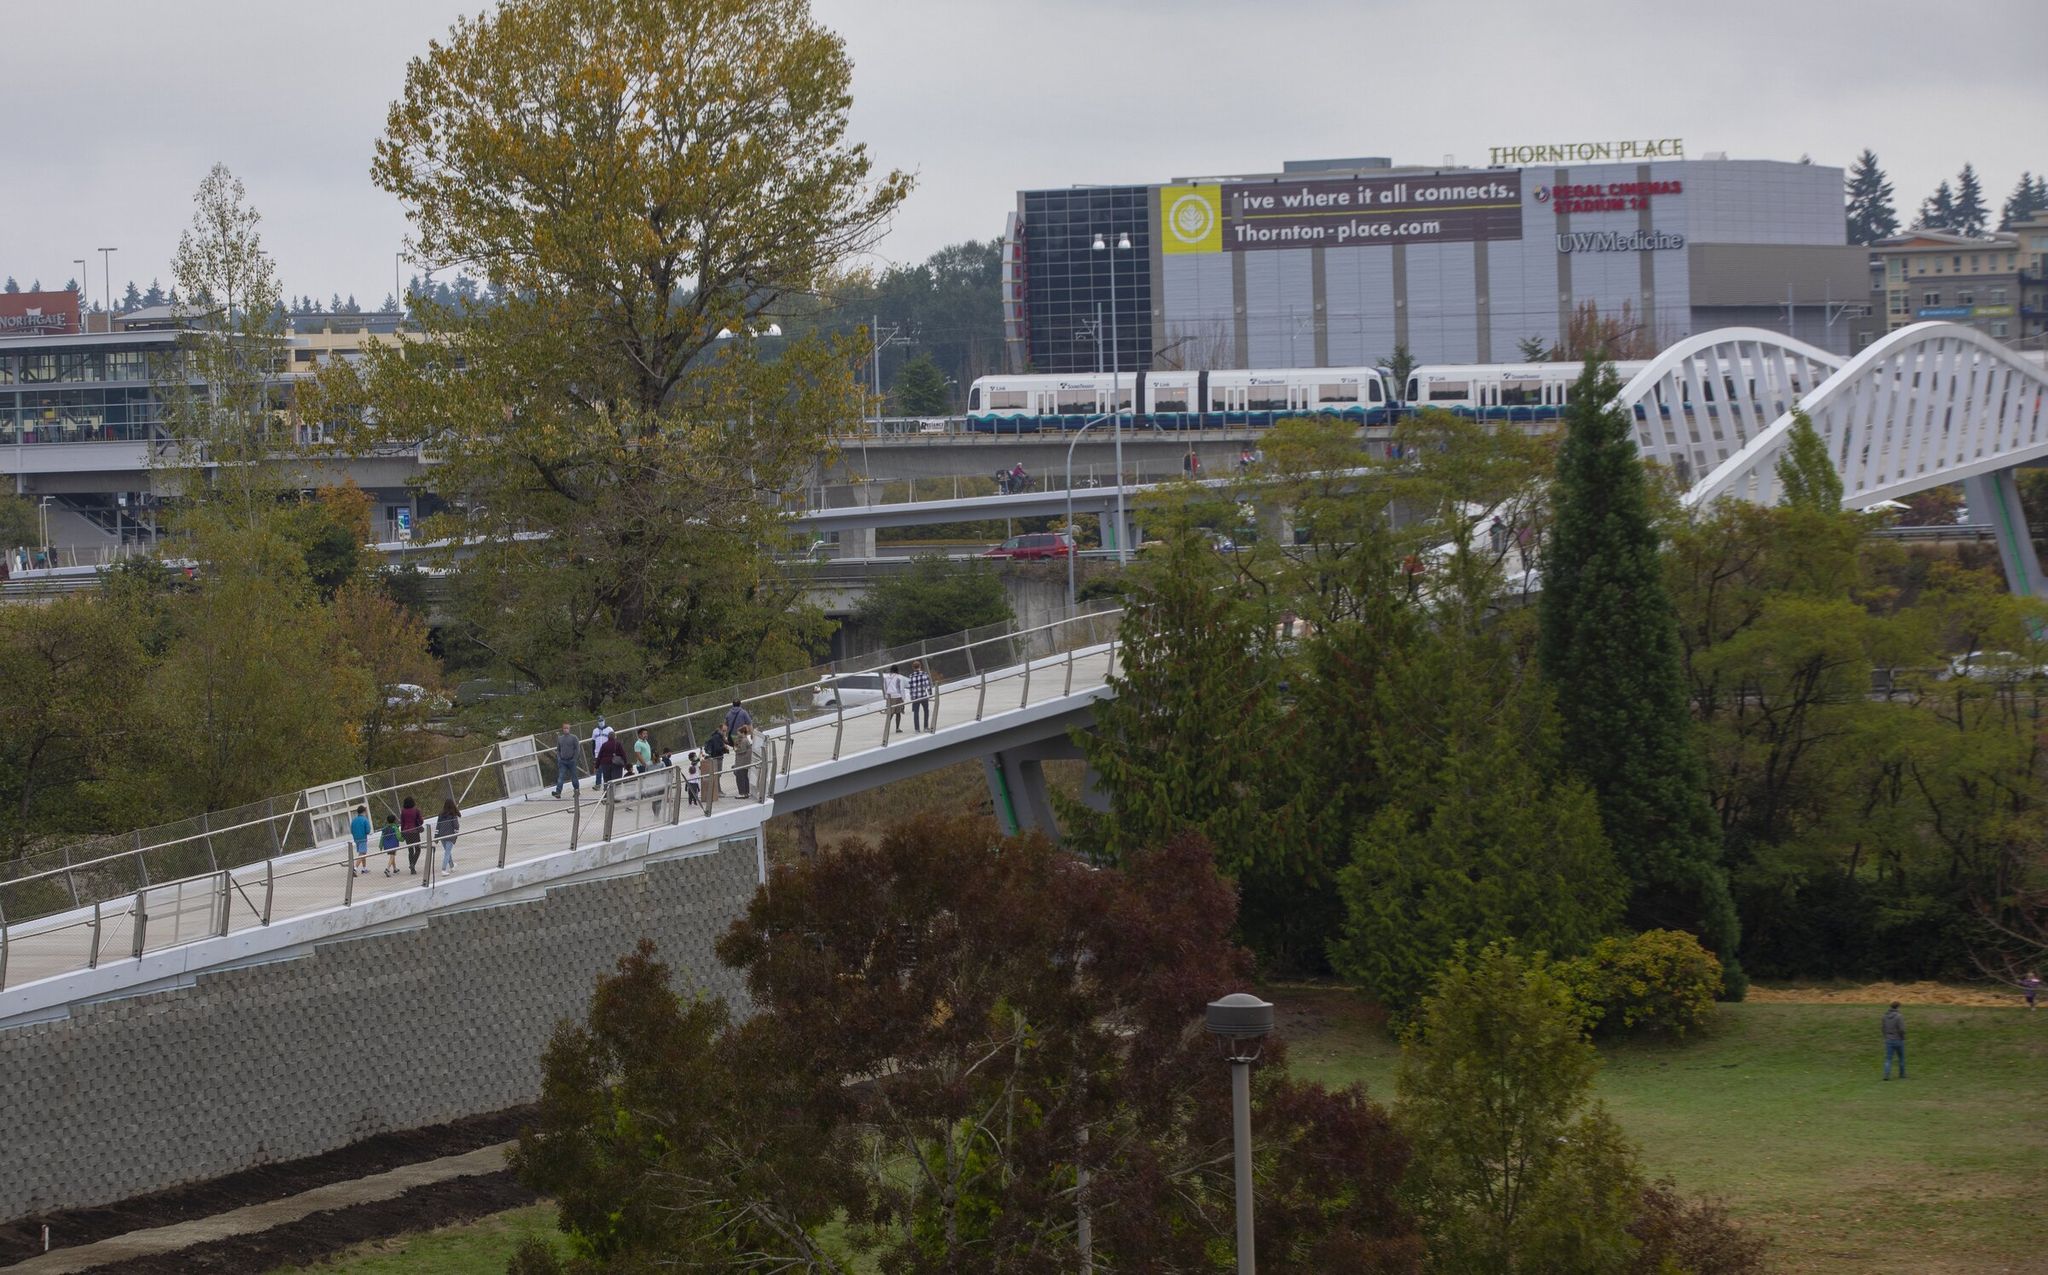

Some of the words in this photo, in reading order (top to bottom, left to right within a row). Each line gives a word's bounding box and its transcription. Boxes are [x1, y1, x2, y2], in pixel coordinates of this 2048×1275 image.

[1488, 143, 1611, 164] THORNTON
[1619, 138, 1683, 161] PLACE
[1233, 191, 1275, 209] ive
[1282, 187, 1350, 208] where
[1357, 185, 1371, 205] it
[1380, 183, 1407, 204] all
[1414, 181, 1515, 202] connects.
[1552, 184, 1602, 199] REGAL
[1608, 180, 1682, 197] CINEMAS
[1553, 198, 1625, 214] STADIUM
[0, 312, 65, 329] NORTHGATE
